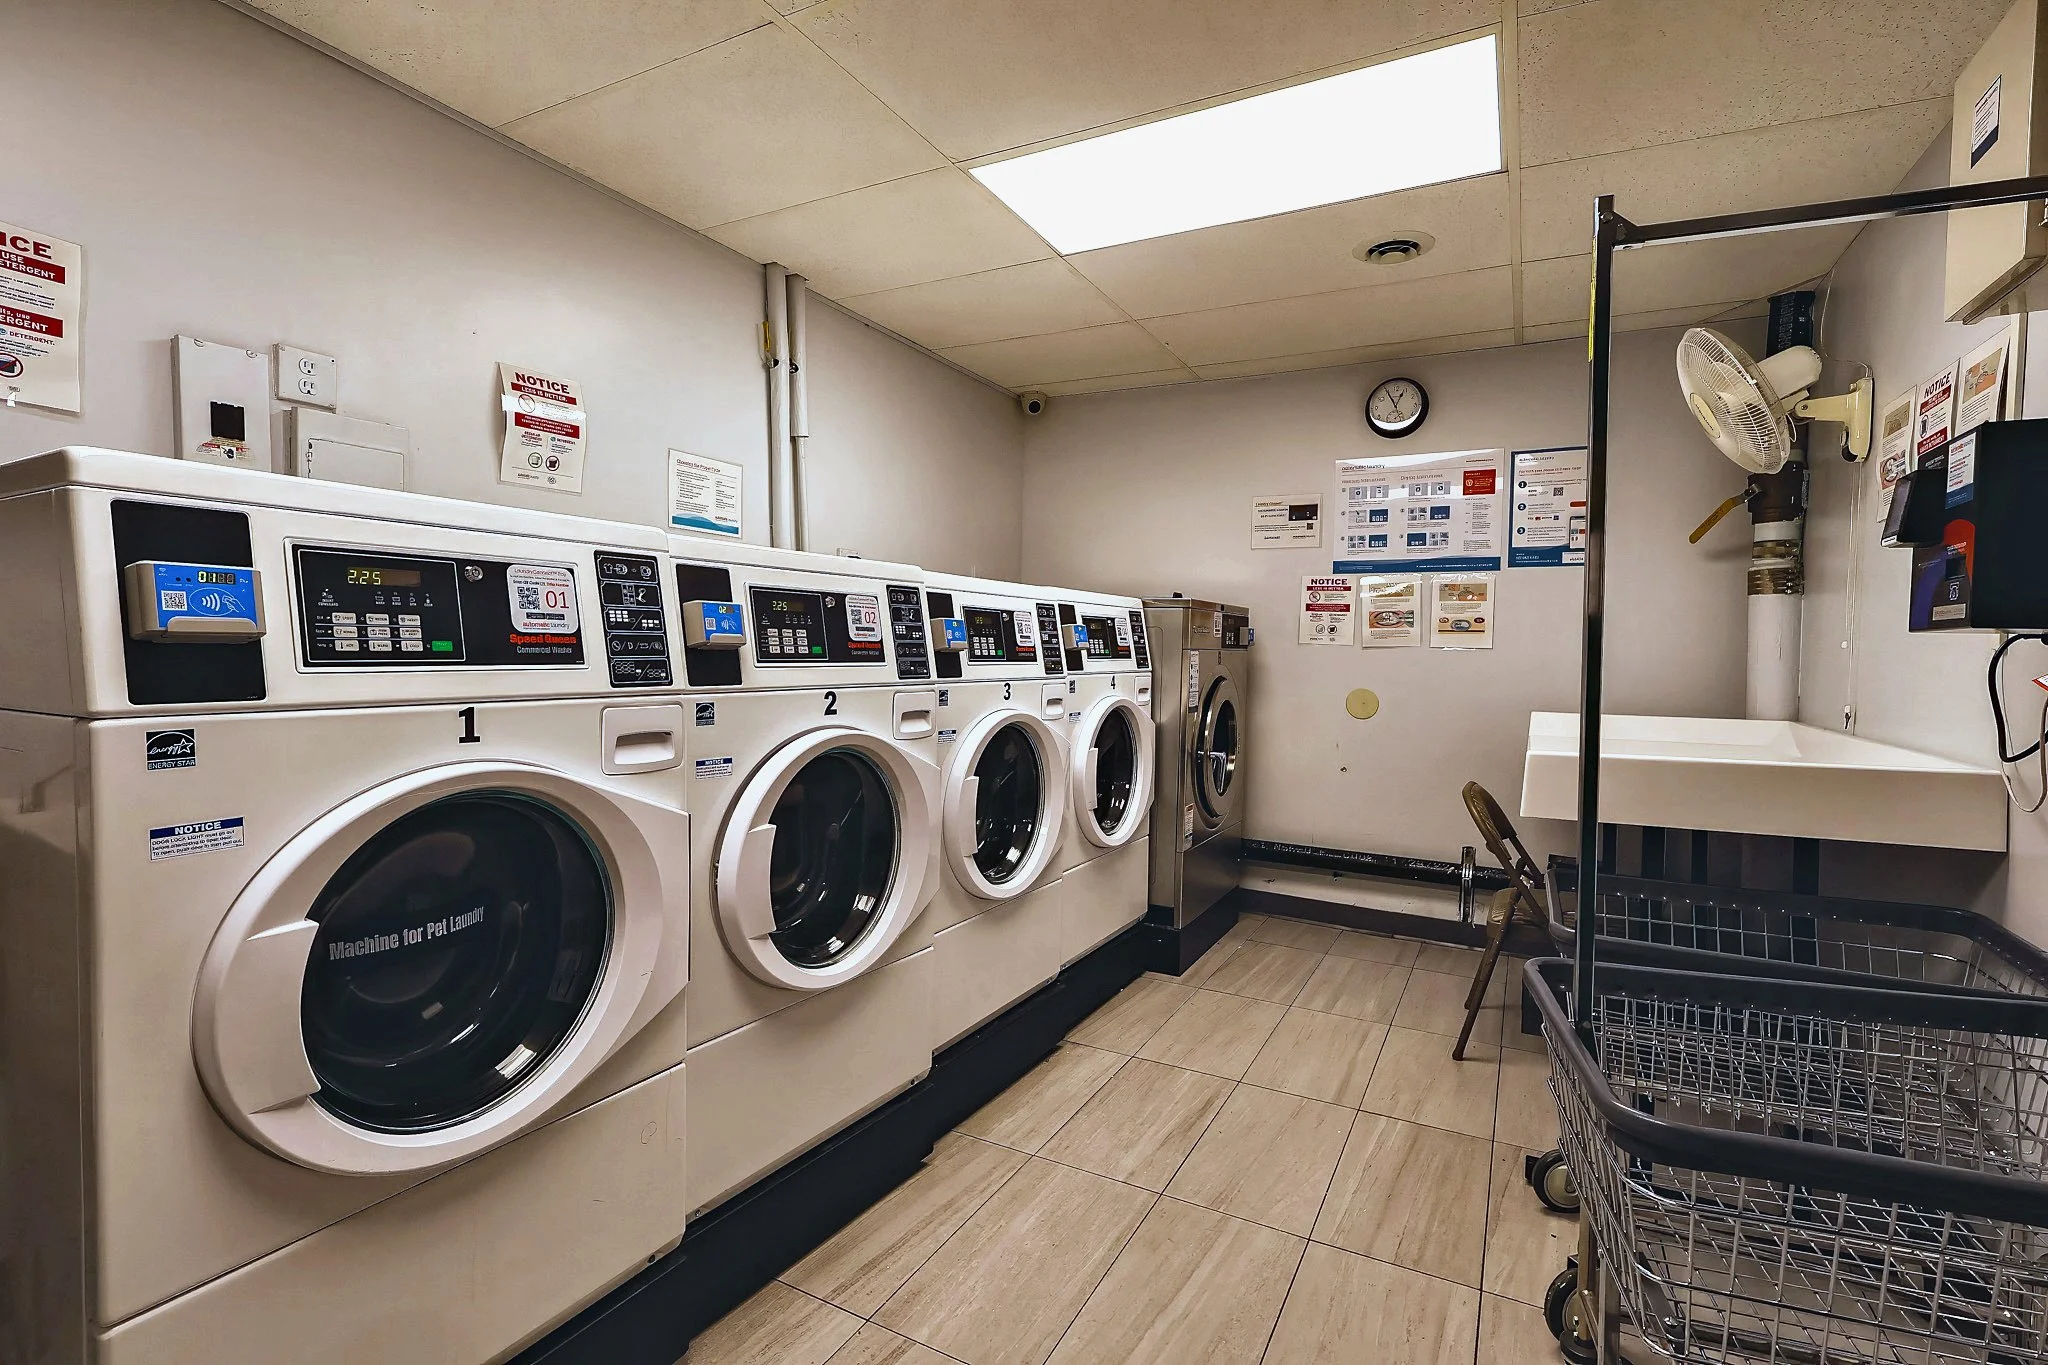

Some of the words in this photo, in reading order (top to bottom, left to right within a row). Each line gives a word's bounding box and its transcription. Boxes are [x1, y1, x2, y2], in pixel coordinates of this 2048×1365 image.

[2, 252, 24, 263] USE
[515, 372, 570, 394] NOTICE
[1924, 371, 1951, 398] NOTICE
[347, 570, 380, 585] 2.25
[545, 591, 570, 609] 01
[865, 612, 877, 624] 02
[510, 634, 544, 644] Speed
[545, 635, 577, 644] Queen
[1111, 675, 1115, 689] 4
[1004, 683, 1011, 700] 3
[824, 691, 837, 716] 2
[459, 706, 480, 744] 1
[148, 761, 176, 769] ENERGY
[174, 822, 222, 835] NOTICE
[329, 933, 399, 961] Machine
[403, 927, 424, 946] for
[427, 918, 448, 939] Pet
[450, 906, 484, 933] Laundry
